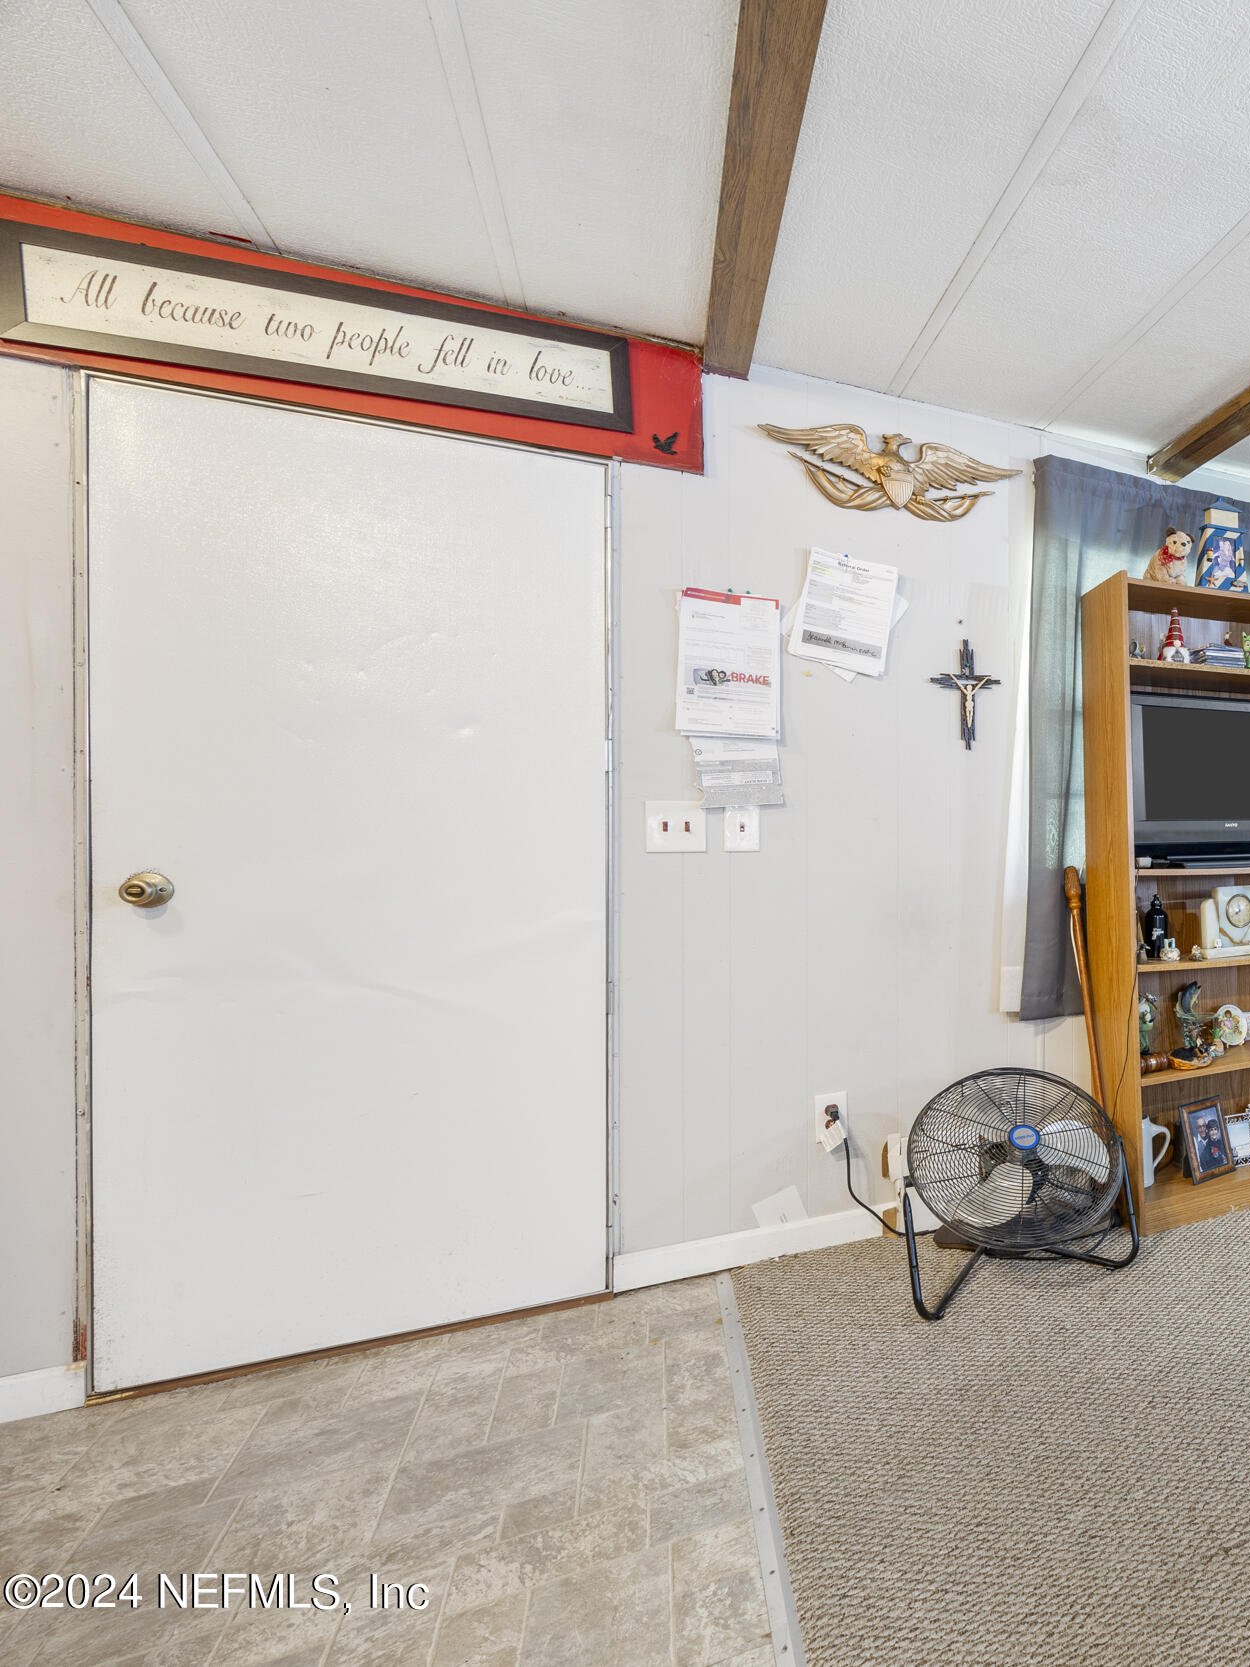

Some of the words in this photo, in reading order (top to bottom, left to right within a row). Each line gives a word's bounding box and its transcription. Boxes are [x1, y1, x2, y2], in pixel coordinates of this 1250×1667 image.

[59, 268, 118, 310] All
[141, 281, 244, 330] because
[264, 311, 318, 343] two
[327, 322, 412, 368] people
[417, 334, 471, 375] fell
[486, 350, 514, 377] in
[528, 352, 593, 391] love...
[730, 671, 770, 686] BRAKE
